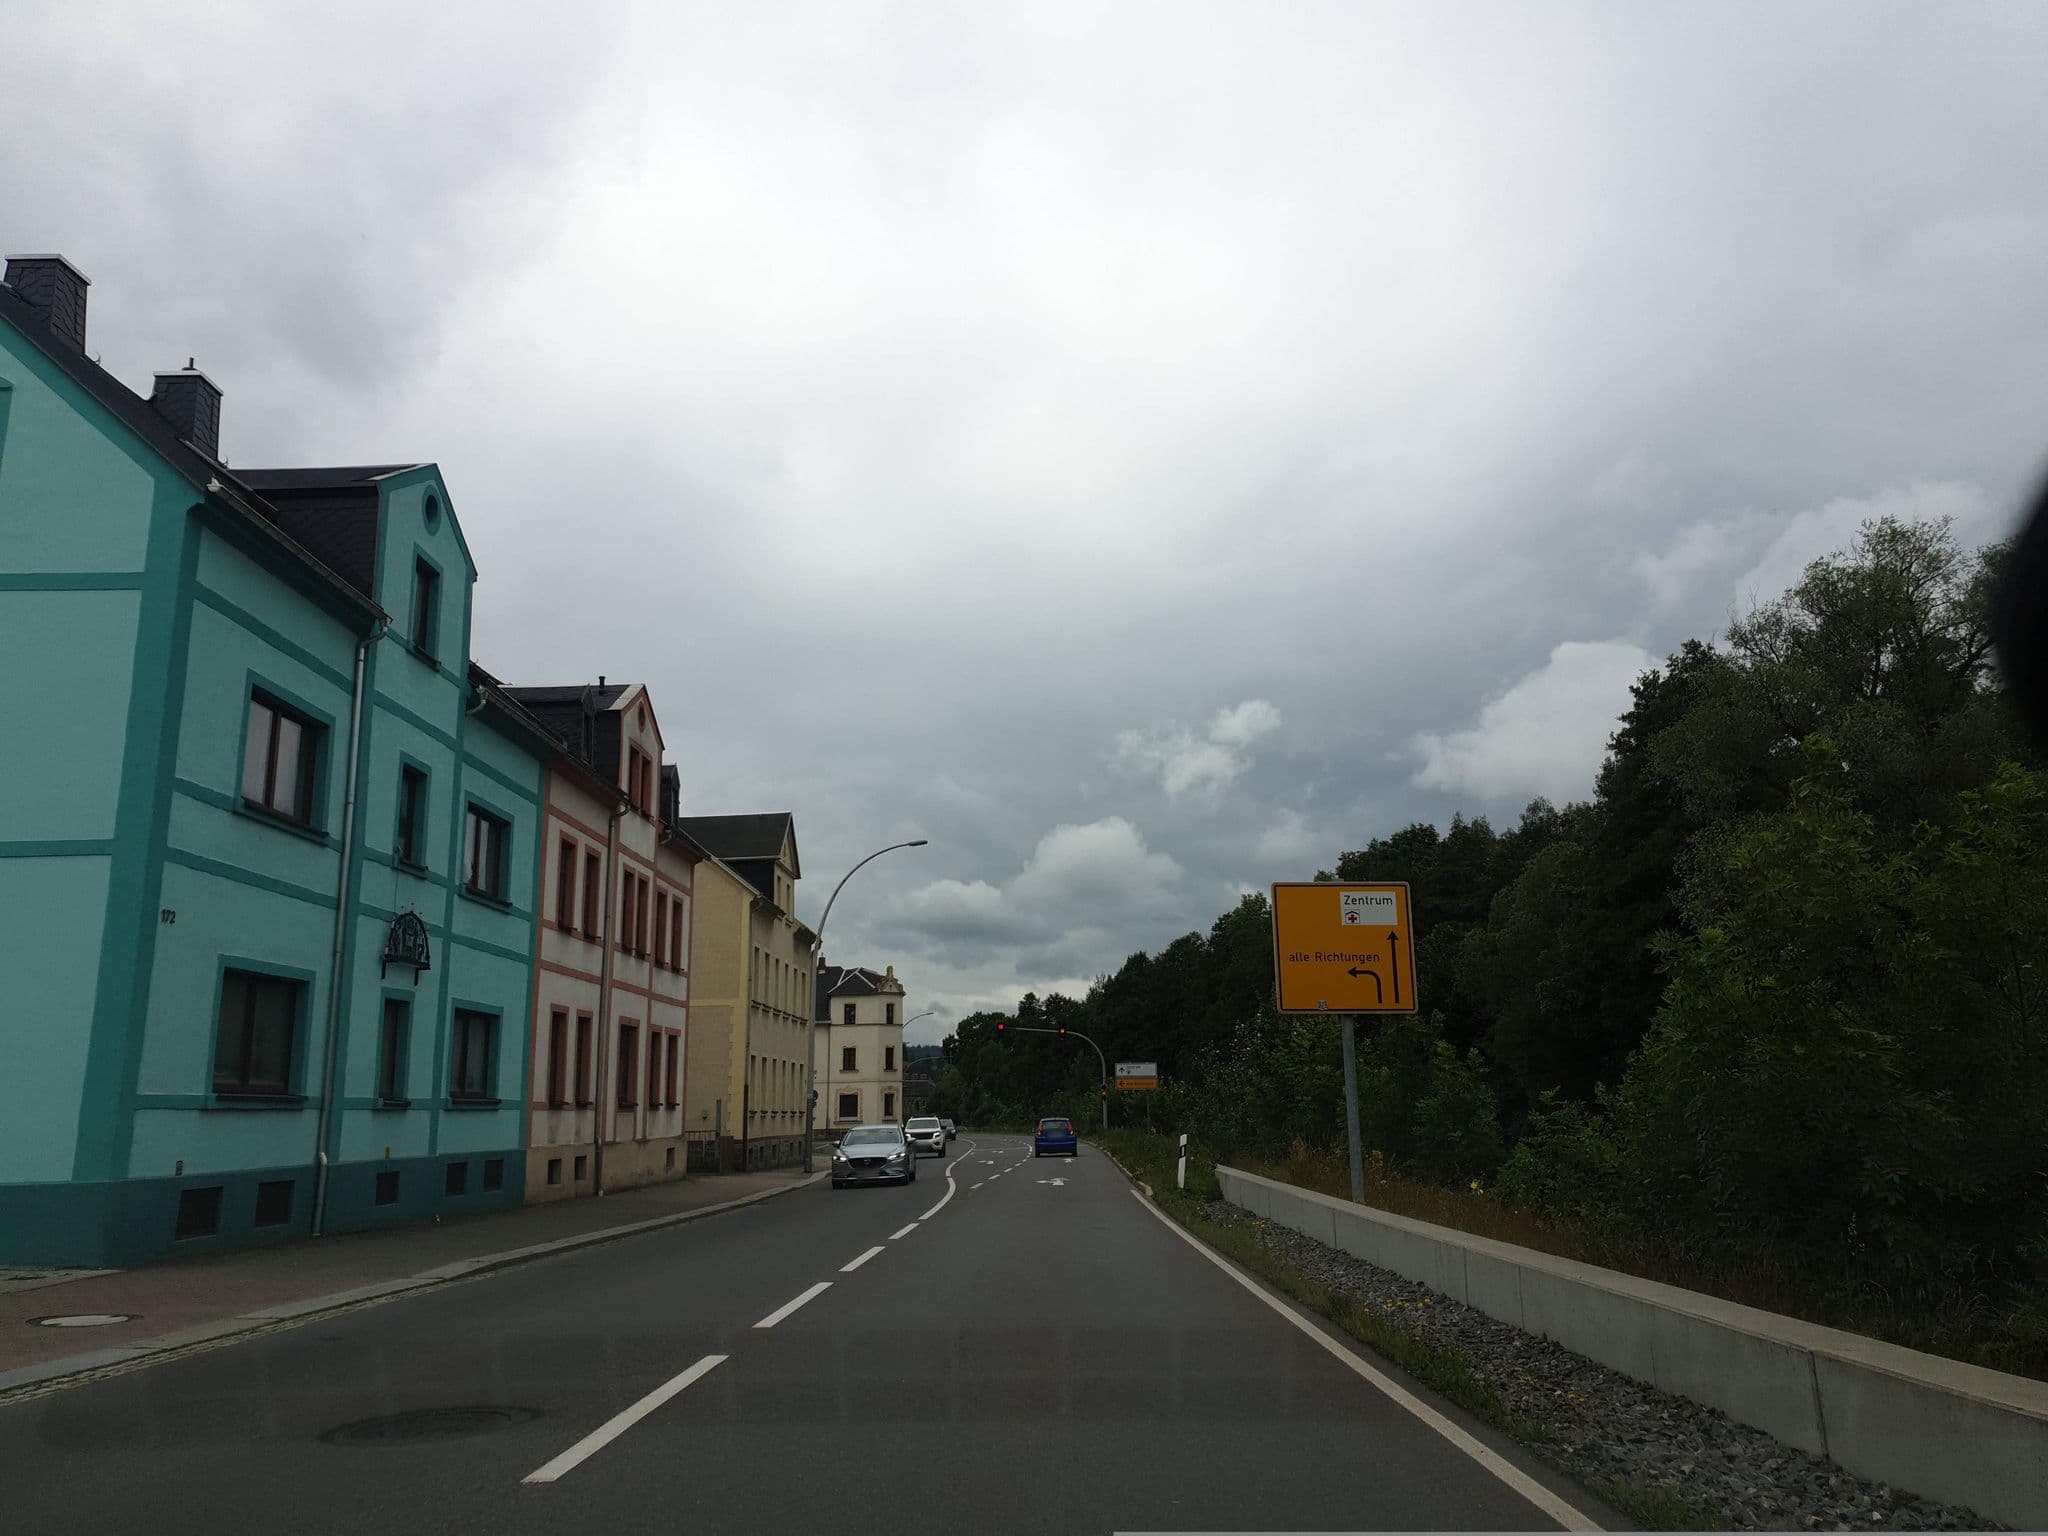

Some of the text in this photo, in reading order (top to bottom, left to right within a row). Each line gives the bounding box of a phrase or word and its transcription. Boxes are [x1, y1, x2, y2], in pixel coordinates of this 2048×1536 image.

[1344, 895, 1393, 905] Zentrum
[161, 909, 176, 924] 172
[1289, 952, 1380, 964] alle Richtungen
